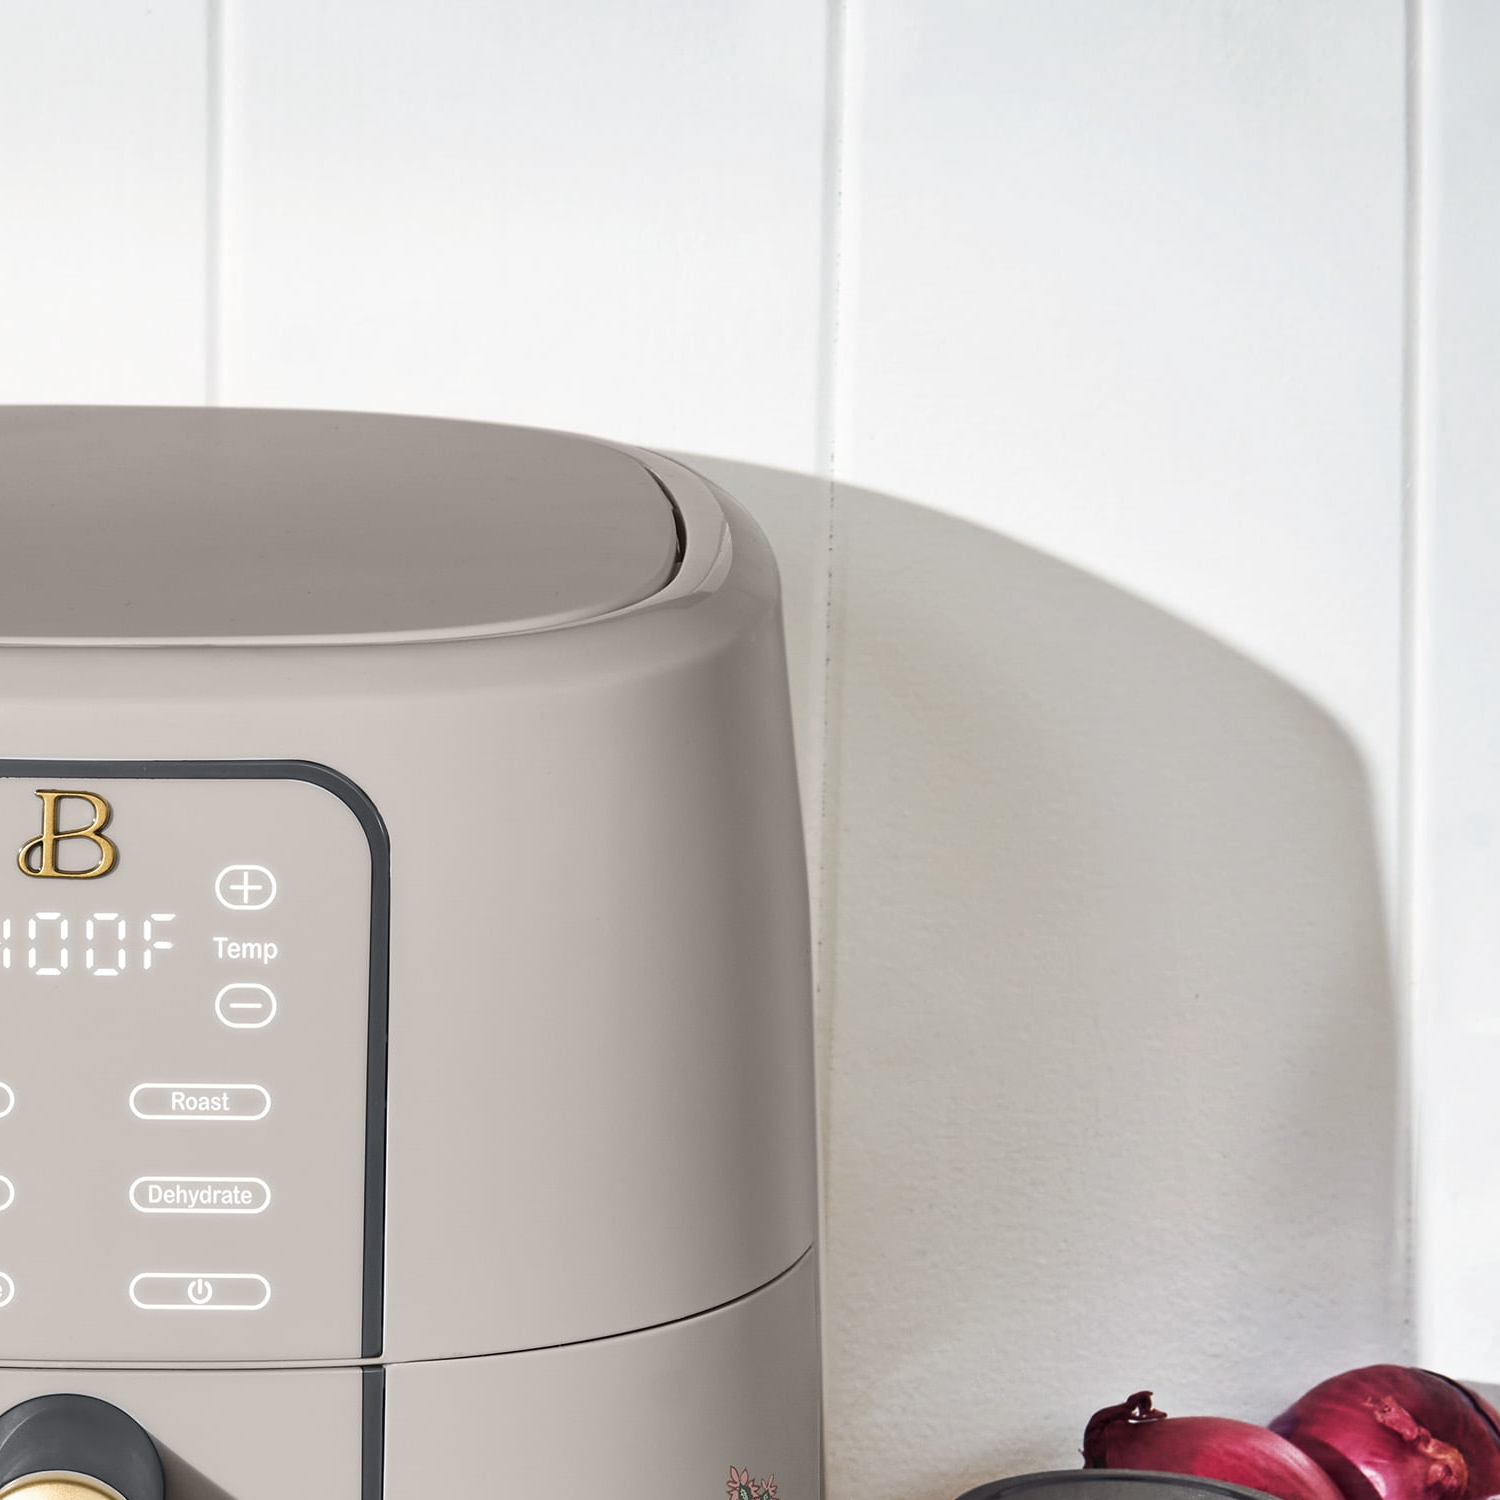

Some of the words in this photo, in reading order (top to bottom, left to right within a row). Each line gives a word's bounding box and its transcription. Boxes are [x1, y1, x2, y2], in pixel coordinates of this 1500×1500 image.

[16, 788, 118, 879] B
[213, 937, 278, 964] Temp
[170, 1090, 230, 1112] Roast
[147, 1184, 253, 1209] Dehydrate
